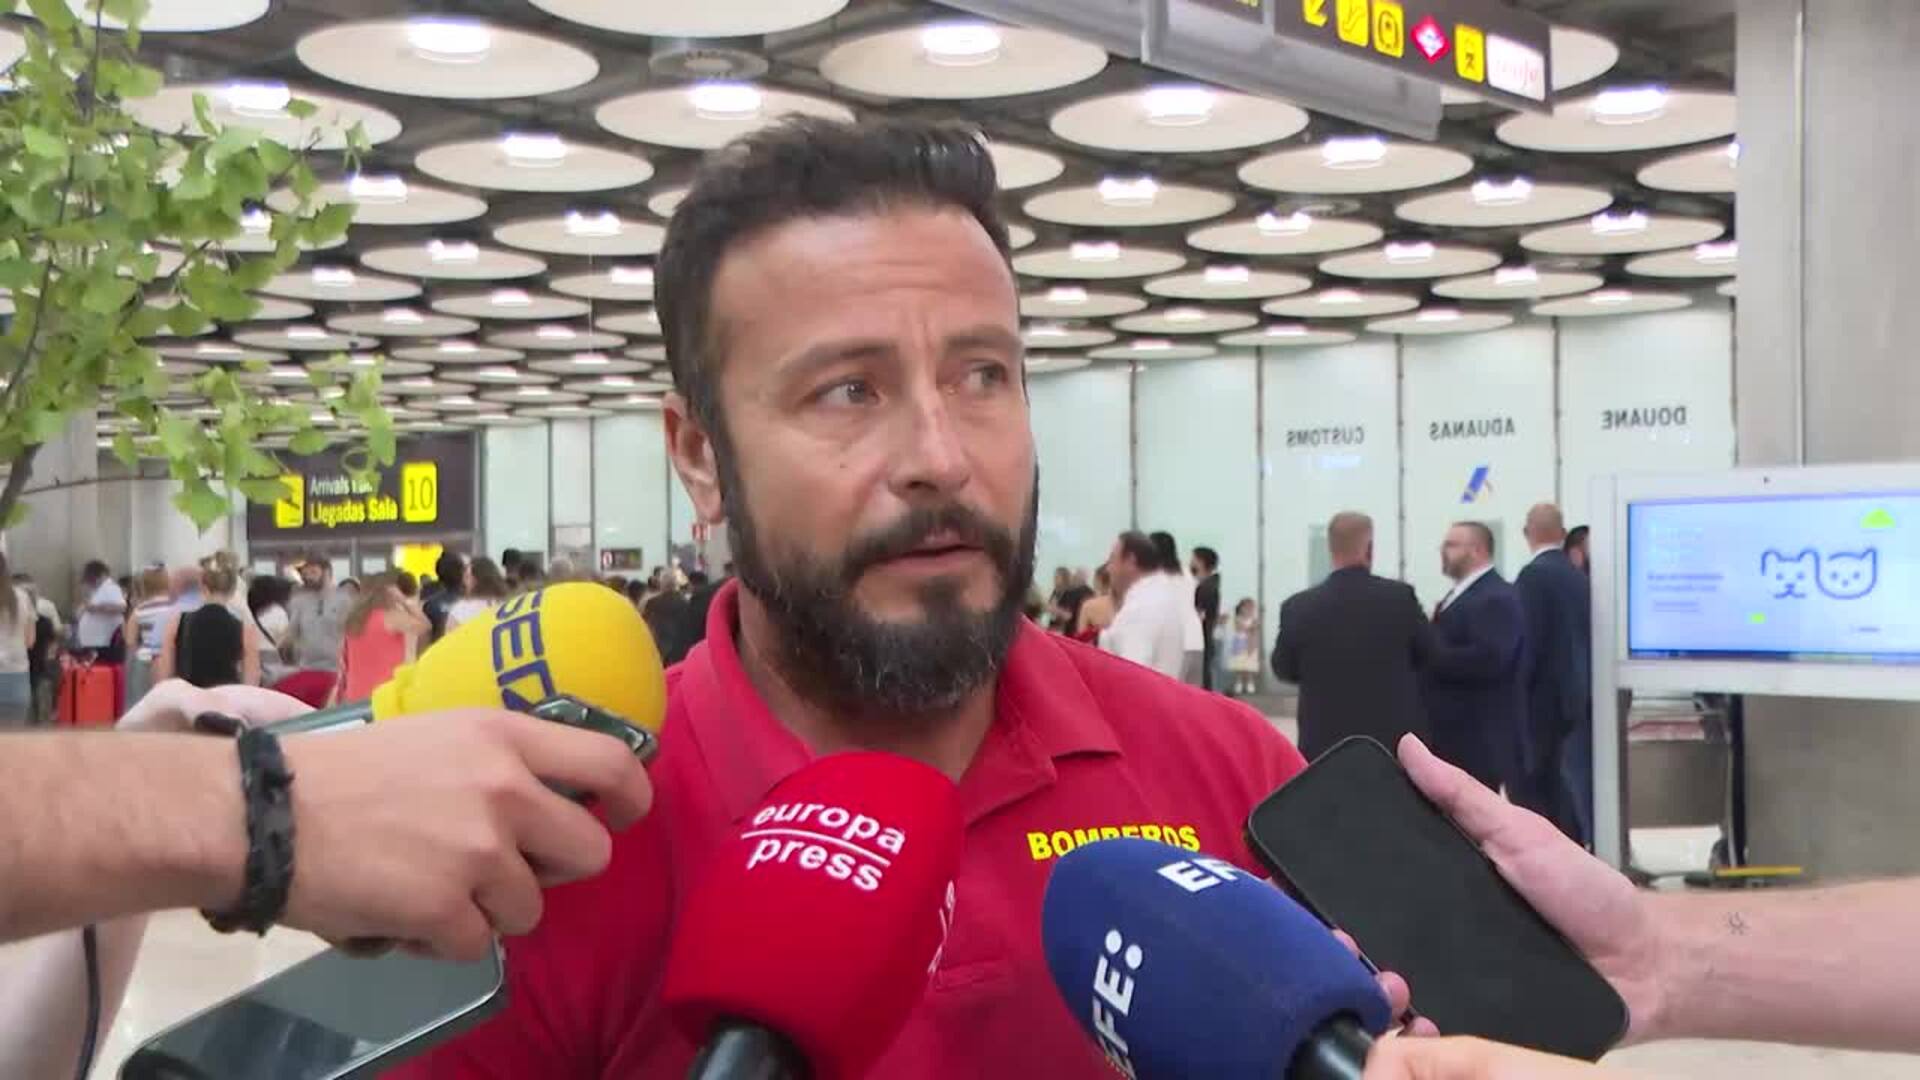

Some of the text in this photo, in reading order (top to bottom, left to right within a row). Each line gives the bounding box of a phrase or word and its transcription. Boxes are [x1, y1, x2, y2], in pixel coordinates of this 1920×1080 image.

[310, 475, 350, 496] Arrivals
[408, 475, 434, 511] 10
[311, 496, 398, 528] Llegadas Sala
[753, 802, 906, 854] europa
[747, 838, 883, 891] press
